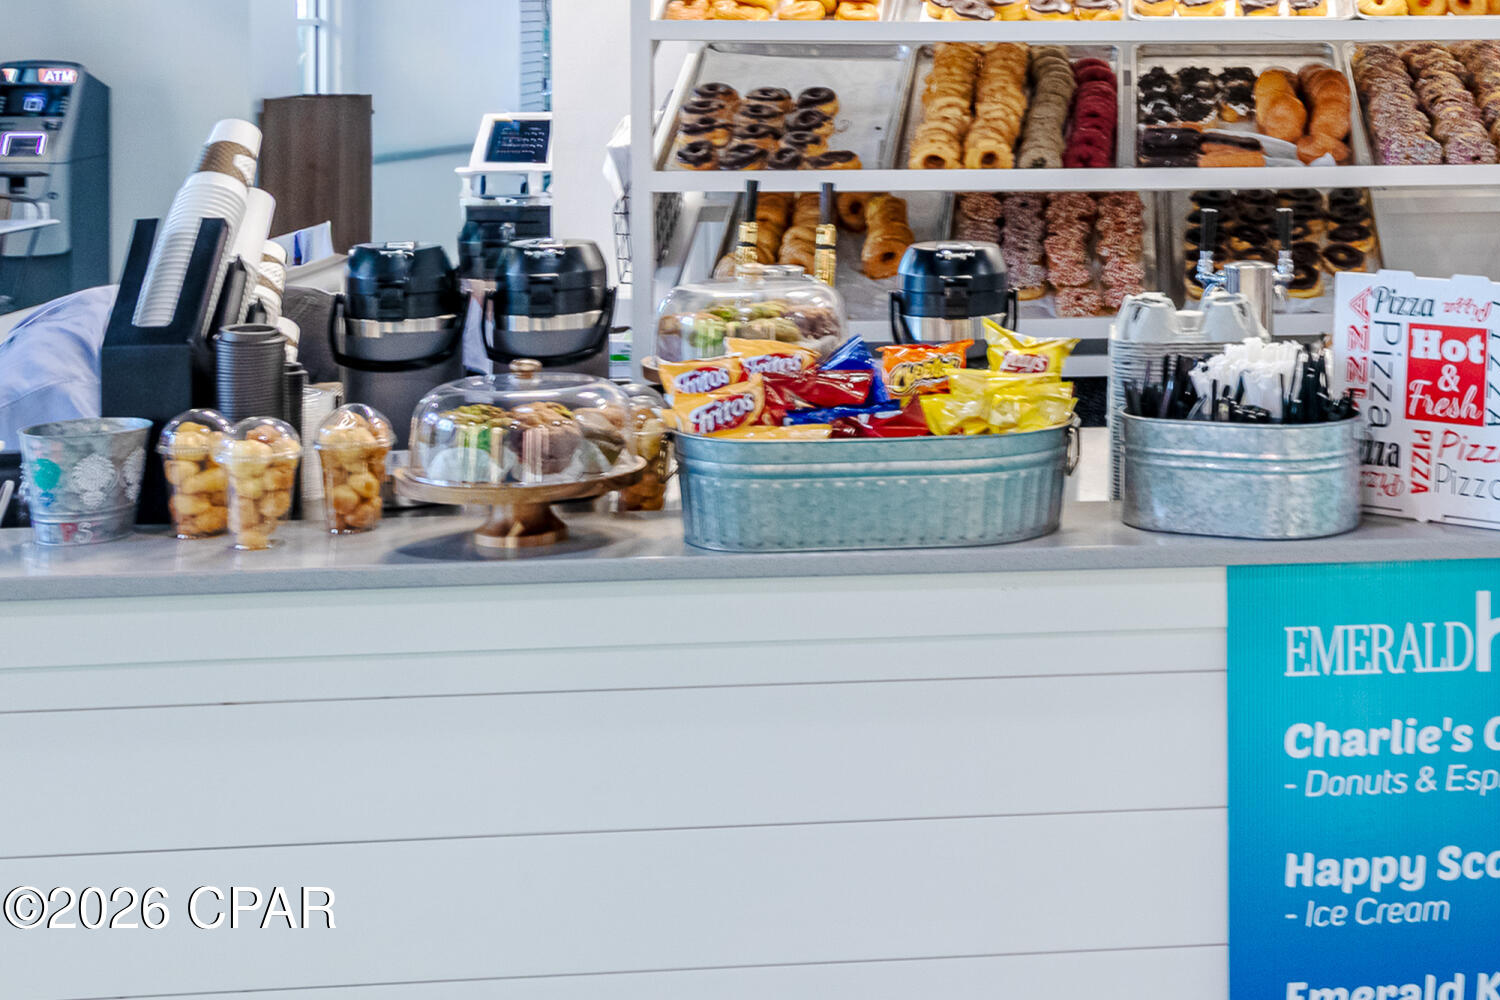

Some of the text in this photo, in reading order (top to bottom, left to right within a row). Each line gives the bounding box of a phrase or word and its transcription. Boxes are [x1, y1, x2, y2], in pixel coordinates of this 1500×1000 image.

[44, 70, 73, 82] ATM
[1372, 285, 1435, 317] Pizza
[1409, 328, 1485, 364] Hot
[675, 368, 729, 394] Fritos
[1368, 320, 1402, 428] Pizza
[1437, 364, 1461, 393] &
[689, 393, 754, 433] Fritos
[1408, 379, 1483, 420] Fresh
[1410, 429, 1432, 494] PIZZA
[1284, 717, 1474, 759] Charlie's
[1305, 767, 1408, 798] Donuts
[1414, 765, 1438, 793] &
[1284, 852, 1427, 892] Happy
[1305, 897, 1451, 927] Ice Cream
